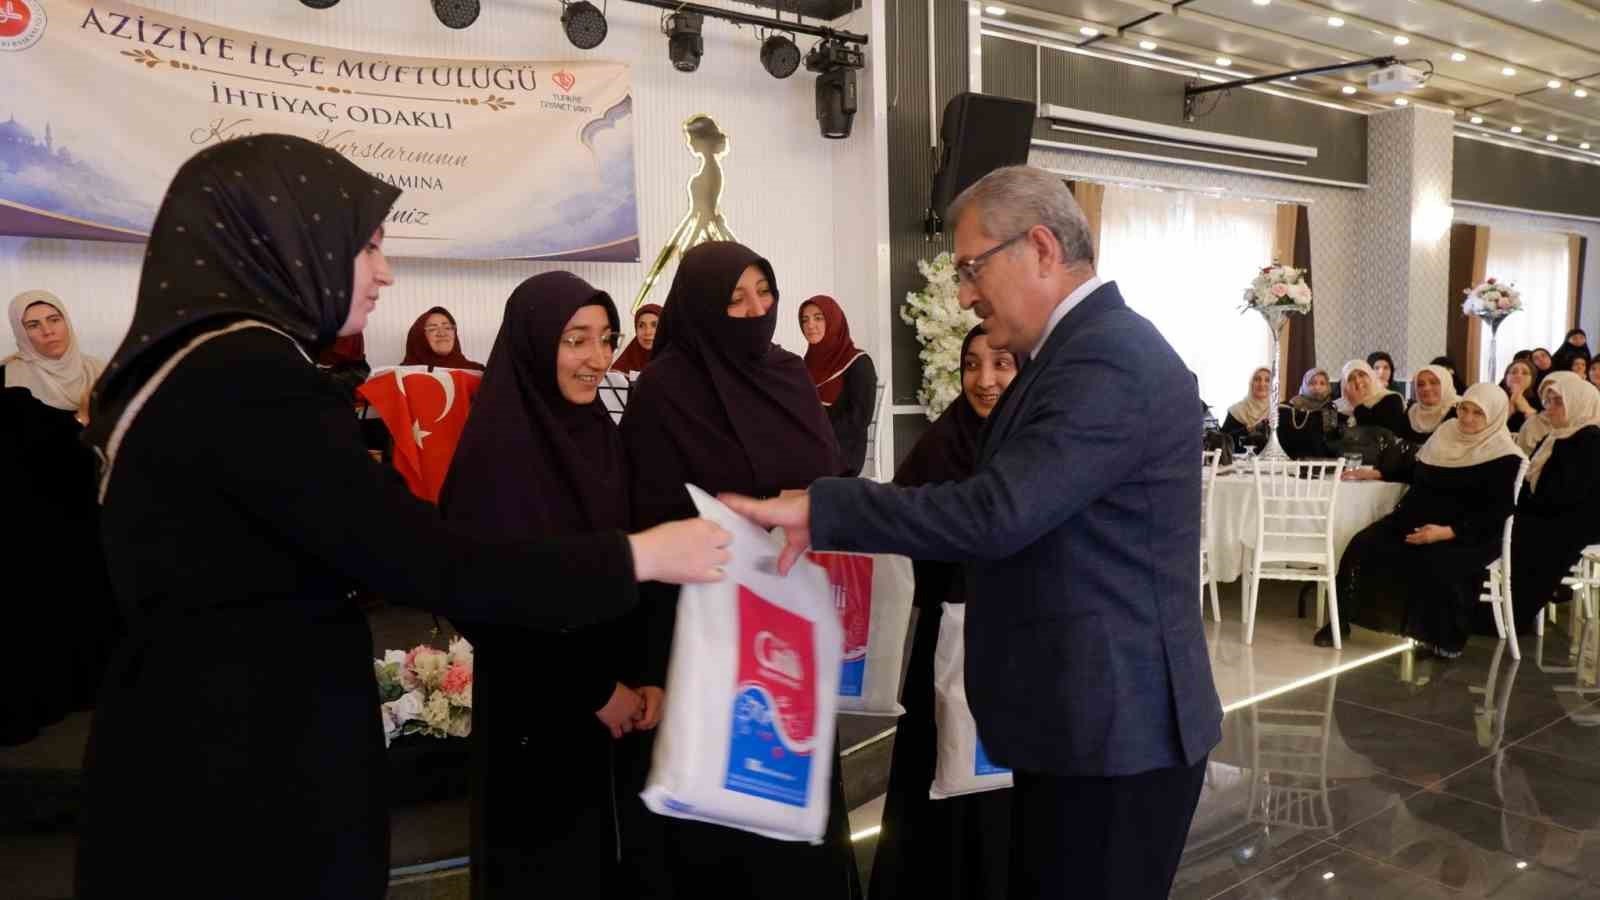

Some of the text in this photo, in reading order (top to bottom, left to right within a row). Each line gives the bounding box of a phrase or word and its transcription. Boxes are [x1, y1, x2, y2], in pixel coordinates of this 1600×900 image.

[81, 7, 235, 61] AZİZİYE
[250, 40, 325, 76] İLÇE
[210, 81, 453, 130] İHTİYAÇ ODAKLI
[370, 172, 444, 191] RAMINA
